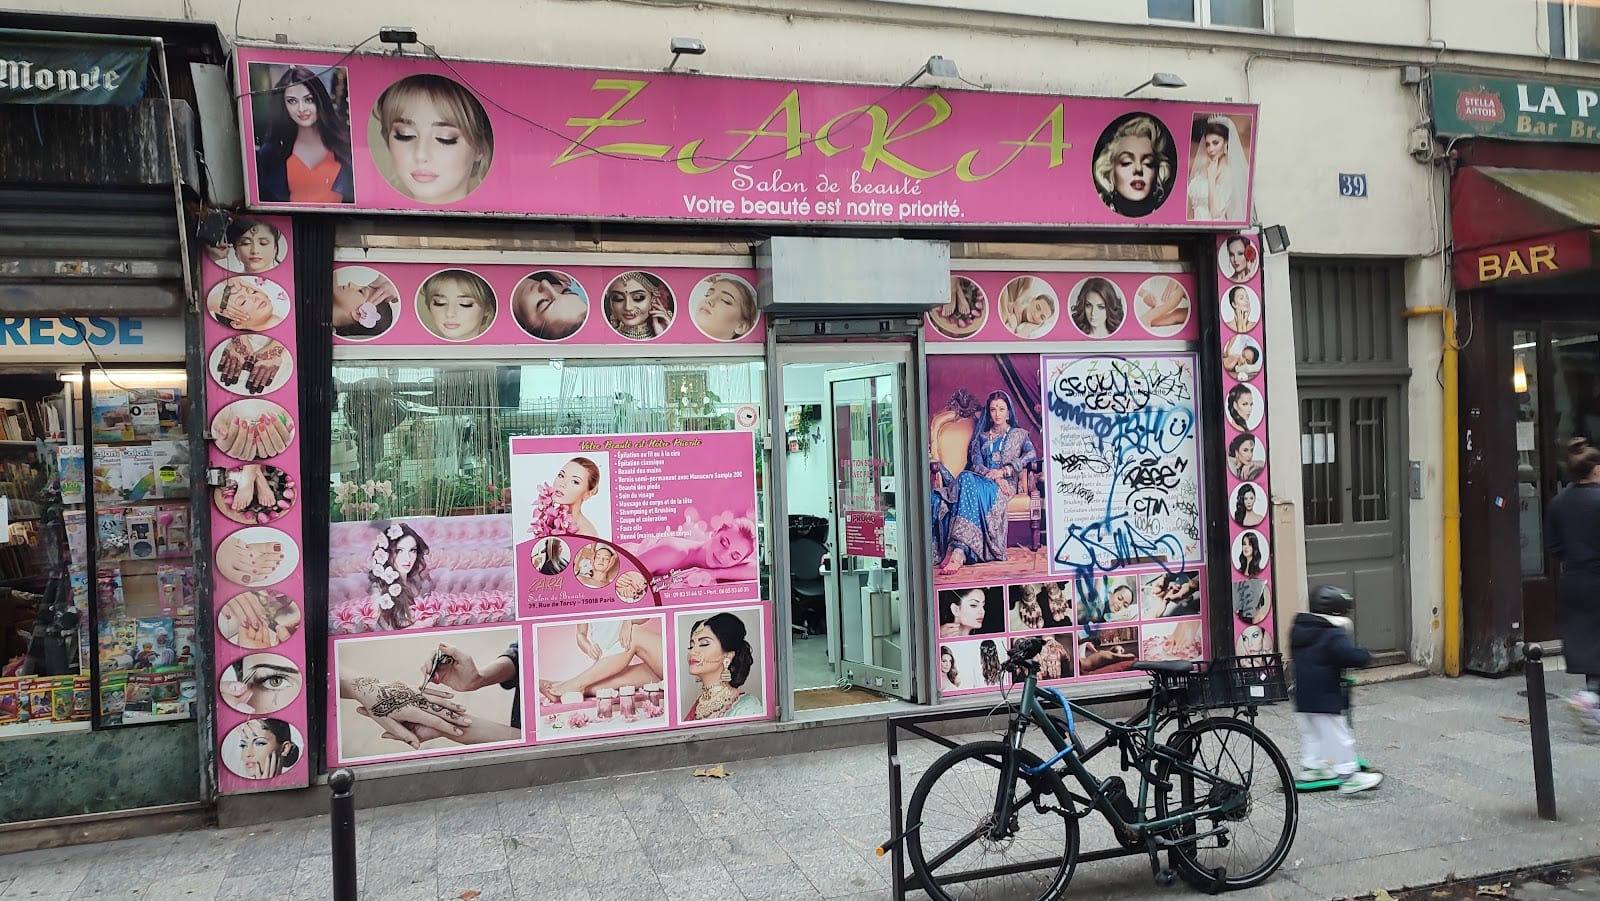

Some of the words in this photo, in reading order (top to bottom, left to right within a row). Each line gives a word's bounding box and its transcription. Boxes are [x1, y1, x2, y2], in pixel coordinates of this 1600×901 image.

[0, 58, 120, 91] Monde
[1465, 97, 1495, 108] STELLA
[1466, 107, 1497, 118] ARTOIS
[1516, 84, 1566, 116] LA
[550, 78, 1073, 182] ZARA
[1516, 115, 1558, 136] Bar
[731, 165, 808, 193] Salon
[815, 174, 840, 193] de
[850, 170, 922, 195] beauté
[1342, 175, 1365, 197] 39
[682, 195, 735, 214] Votre
[741, 196, 811, 216] beauté
[814, 200, 841, 215] est
[846, 200, 893, 217] notre
[898, 198, 965, 220] priorité.
[1478, 244, 1559, 282] BAR
[528, 576, 563, 593] ZARA
